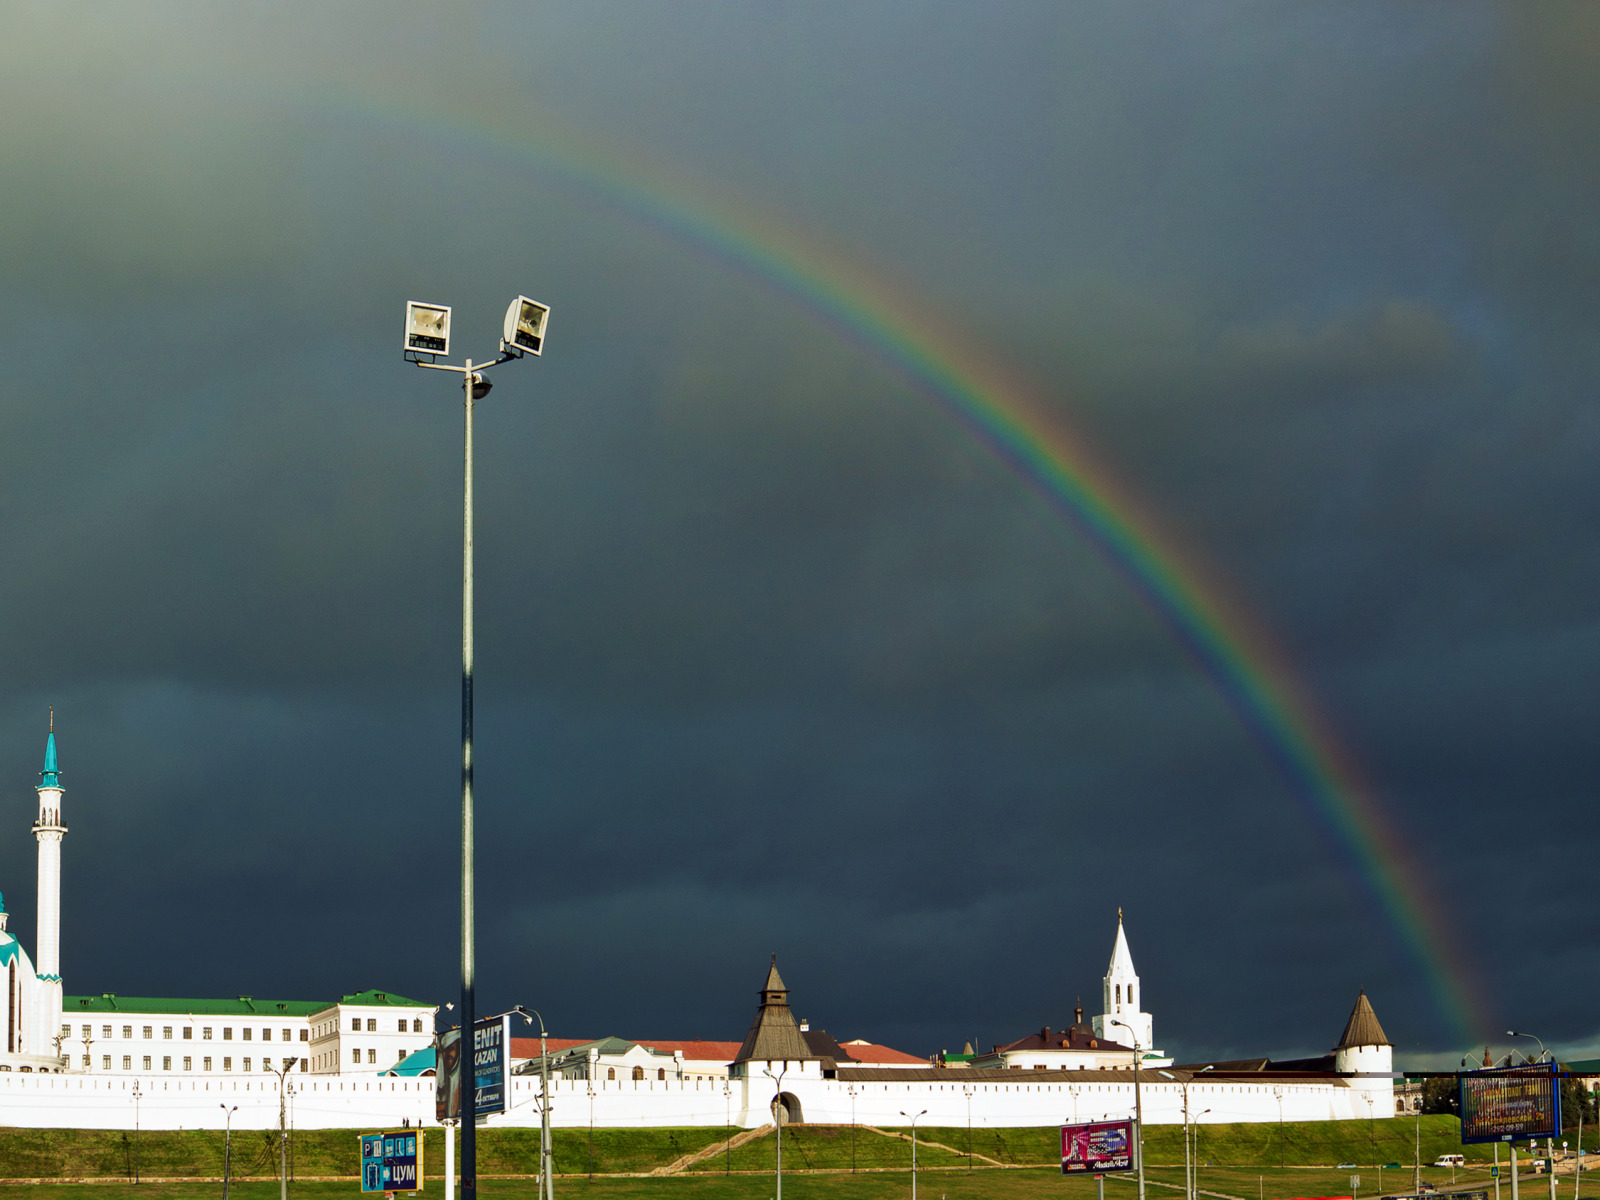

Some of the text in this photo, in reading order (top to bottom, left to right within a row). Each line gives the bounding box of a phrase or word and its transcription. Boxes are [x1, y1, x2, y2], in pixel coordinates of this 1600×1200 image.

[474, 1024, 503, 1050] ENIT
[475, 1088, 483, 1106] 4
[393, 1165, 416, 1185] ЦУМ
